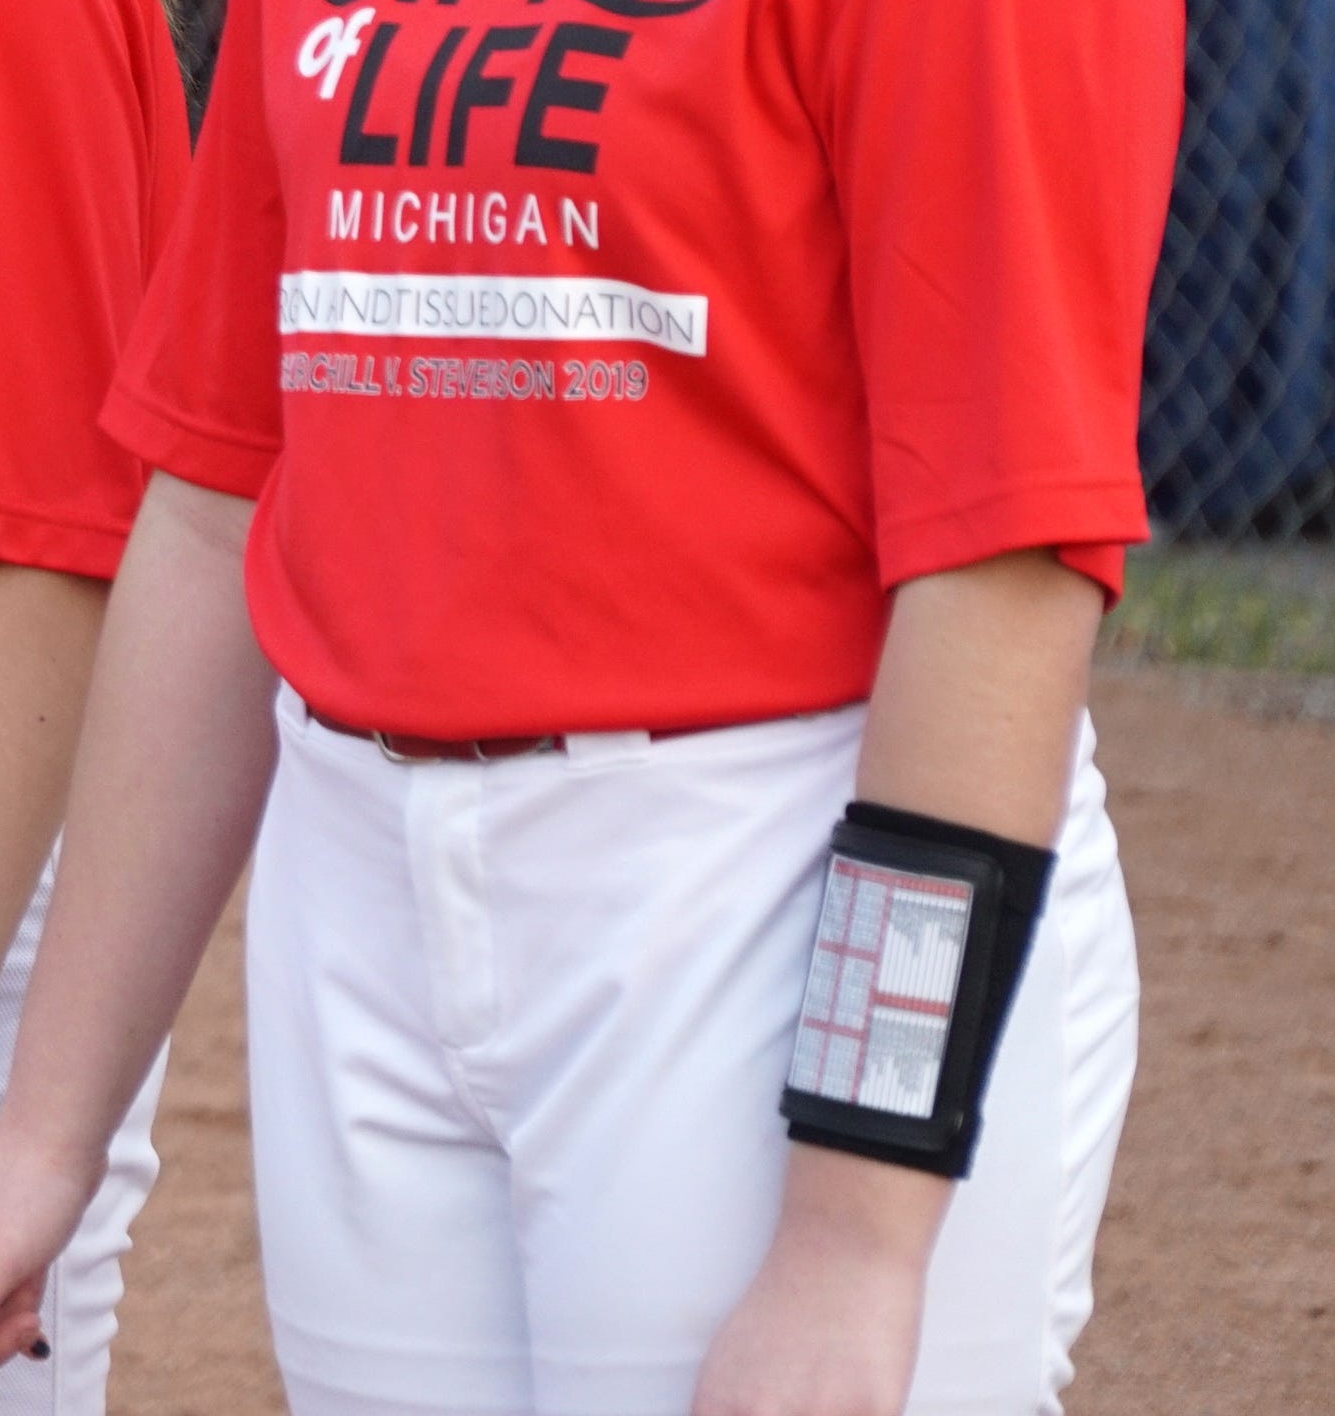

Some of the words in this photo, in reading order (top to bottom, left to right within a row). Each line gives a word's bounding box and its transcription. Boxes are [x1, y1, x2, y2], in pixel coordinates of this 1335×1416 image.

[297, 7, 376, 100] of
[339, 21, 633, 174] LIFE
[329, 188, 599, 249] MICHIGAN
[562, 359, 650, 402] 2019
